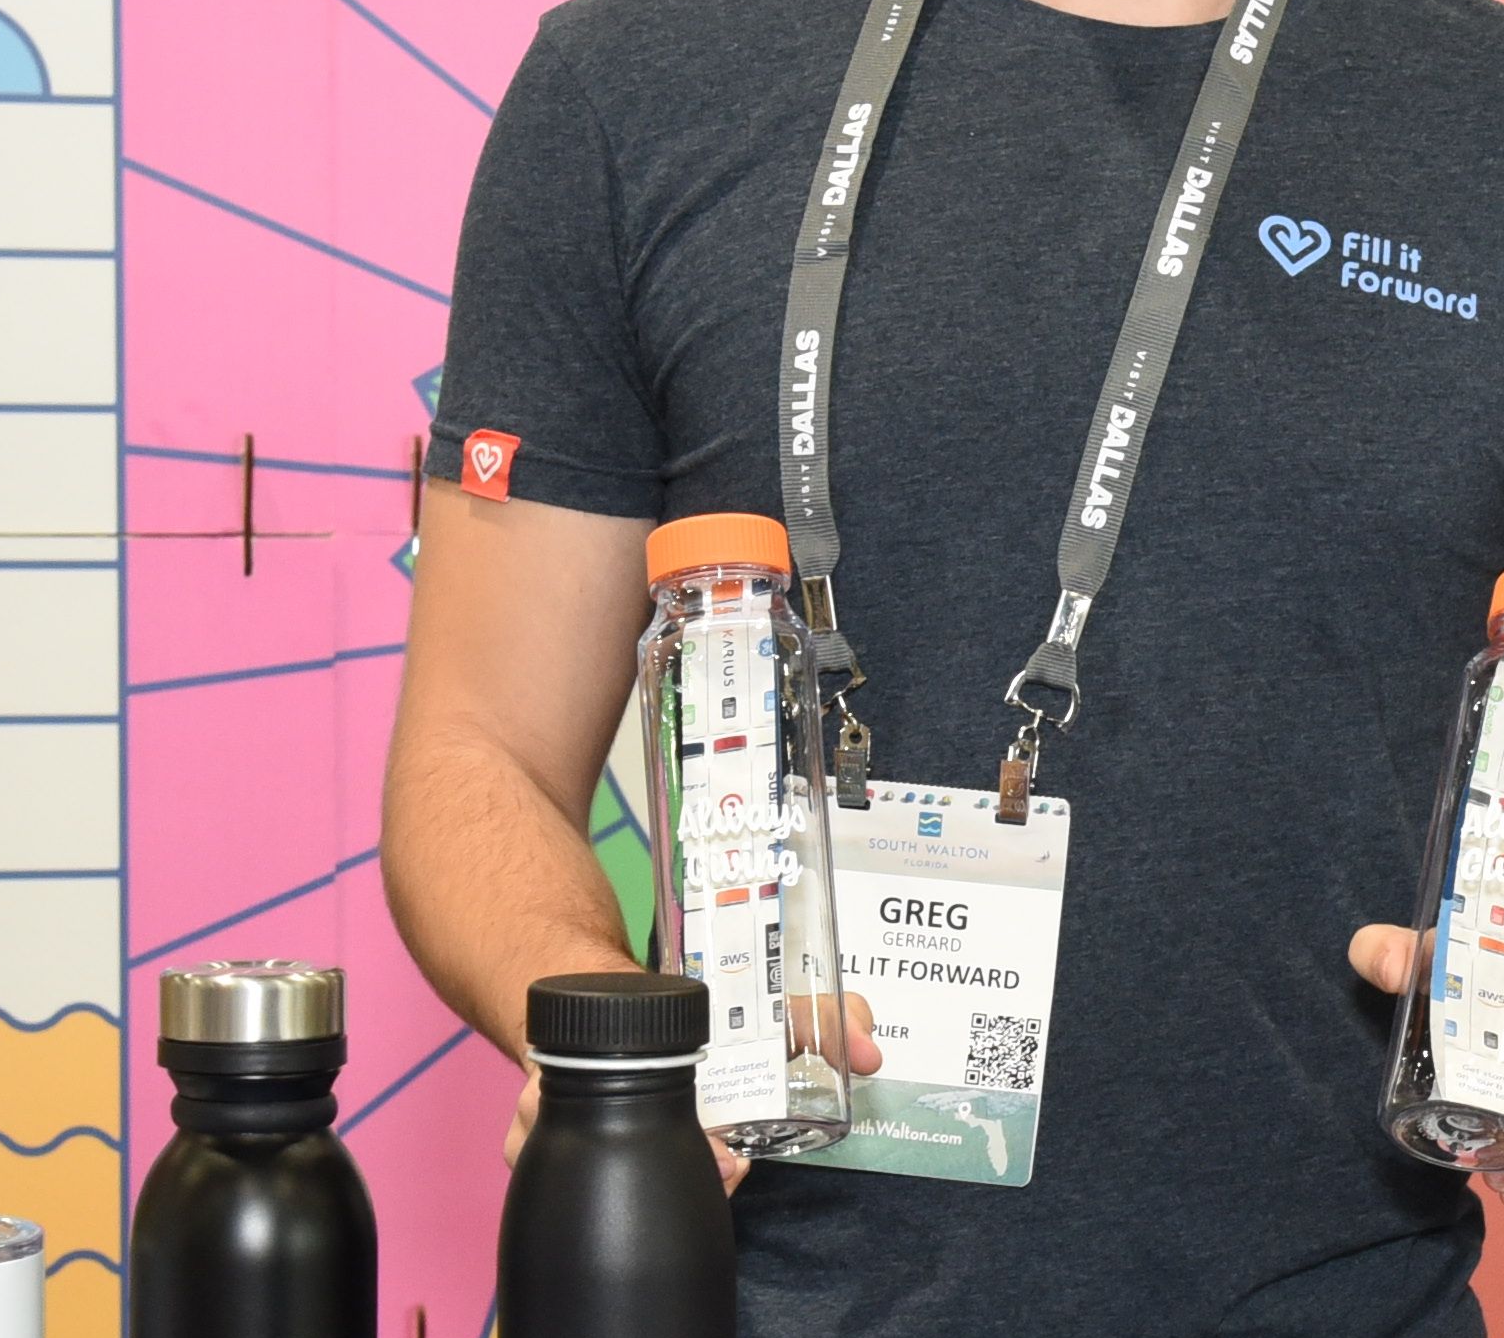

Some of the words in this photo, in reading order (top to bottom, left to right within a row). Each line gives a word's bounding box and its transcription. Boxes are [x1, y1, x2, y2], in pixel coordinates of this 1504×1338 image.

[880, 3, 903, 43] VISIT
[822, 103, 872, 207] DALLAS
[1203, 120, 1222, 163] VISIT
[816, 214, 838, 258] VISIT
[1156, 166, 1214, 278] DALLAS
[1342, 231, 1392, 266] Fill
[1399, 240, 1422, 274] it
[1340, 263, 1478, 321] Forward
[791, 329, 820, 456] DALLAS
[1127, 351, 1147, 400] VISIT
[1080, 404, 1137, 530] DALLAS
[802, 463, 812, 517] VISIT
[721, 628, 736, 688] KARIUS
[676, 795, 807, 842] Always
[687, 845, 804, 887] Giving
[868, 836, 918, 855] SOUTH
[926, 843, 990, 861] WALTON
[903, 857, 950, 871] FLORIDA
[879, 896, 970, 931] GREG
[719, 951, 751, 968] aws
[882, 931, 962, 953] GERRARD
[869, 957, 891, 978] IT
[897, 960, 1021, 991] FORWARD
[700, 1080, 715, 1091] on
[717, 1076, 742, 1092] your
[707, 1063, 727, 1078] Get
[702, 1090, 741, 1105] design
[742, 1086, 775, 1101] today
